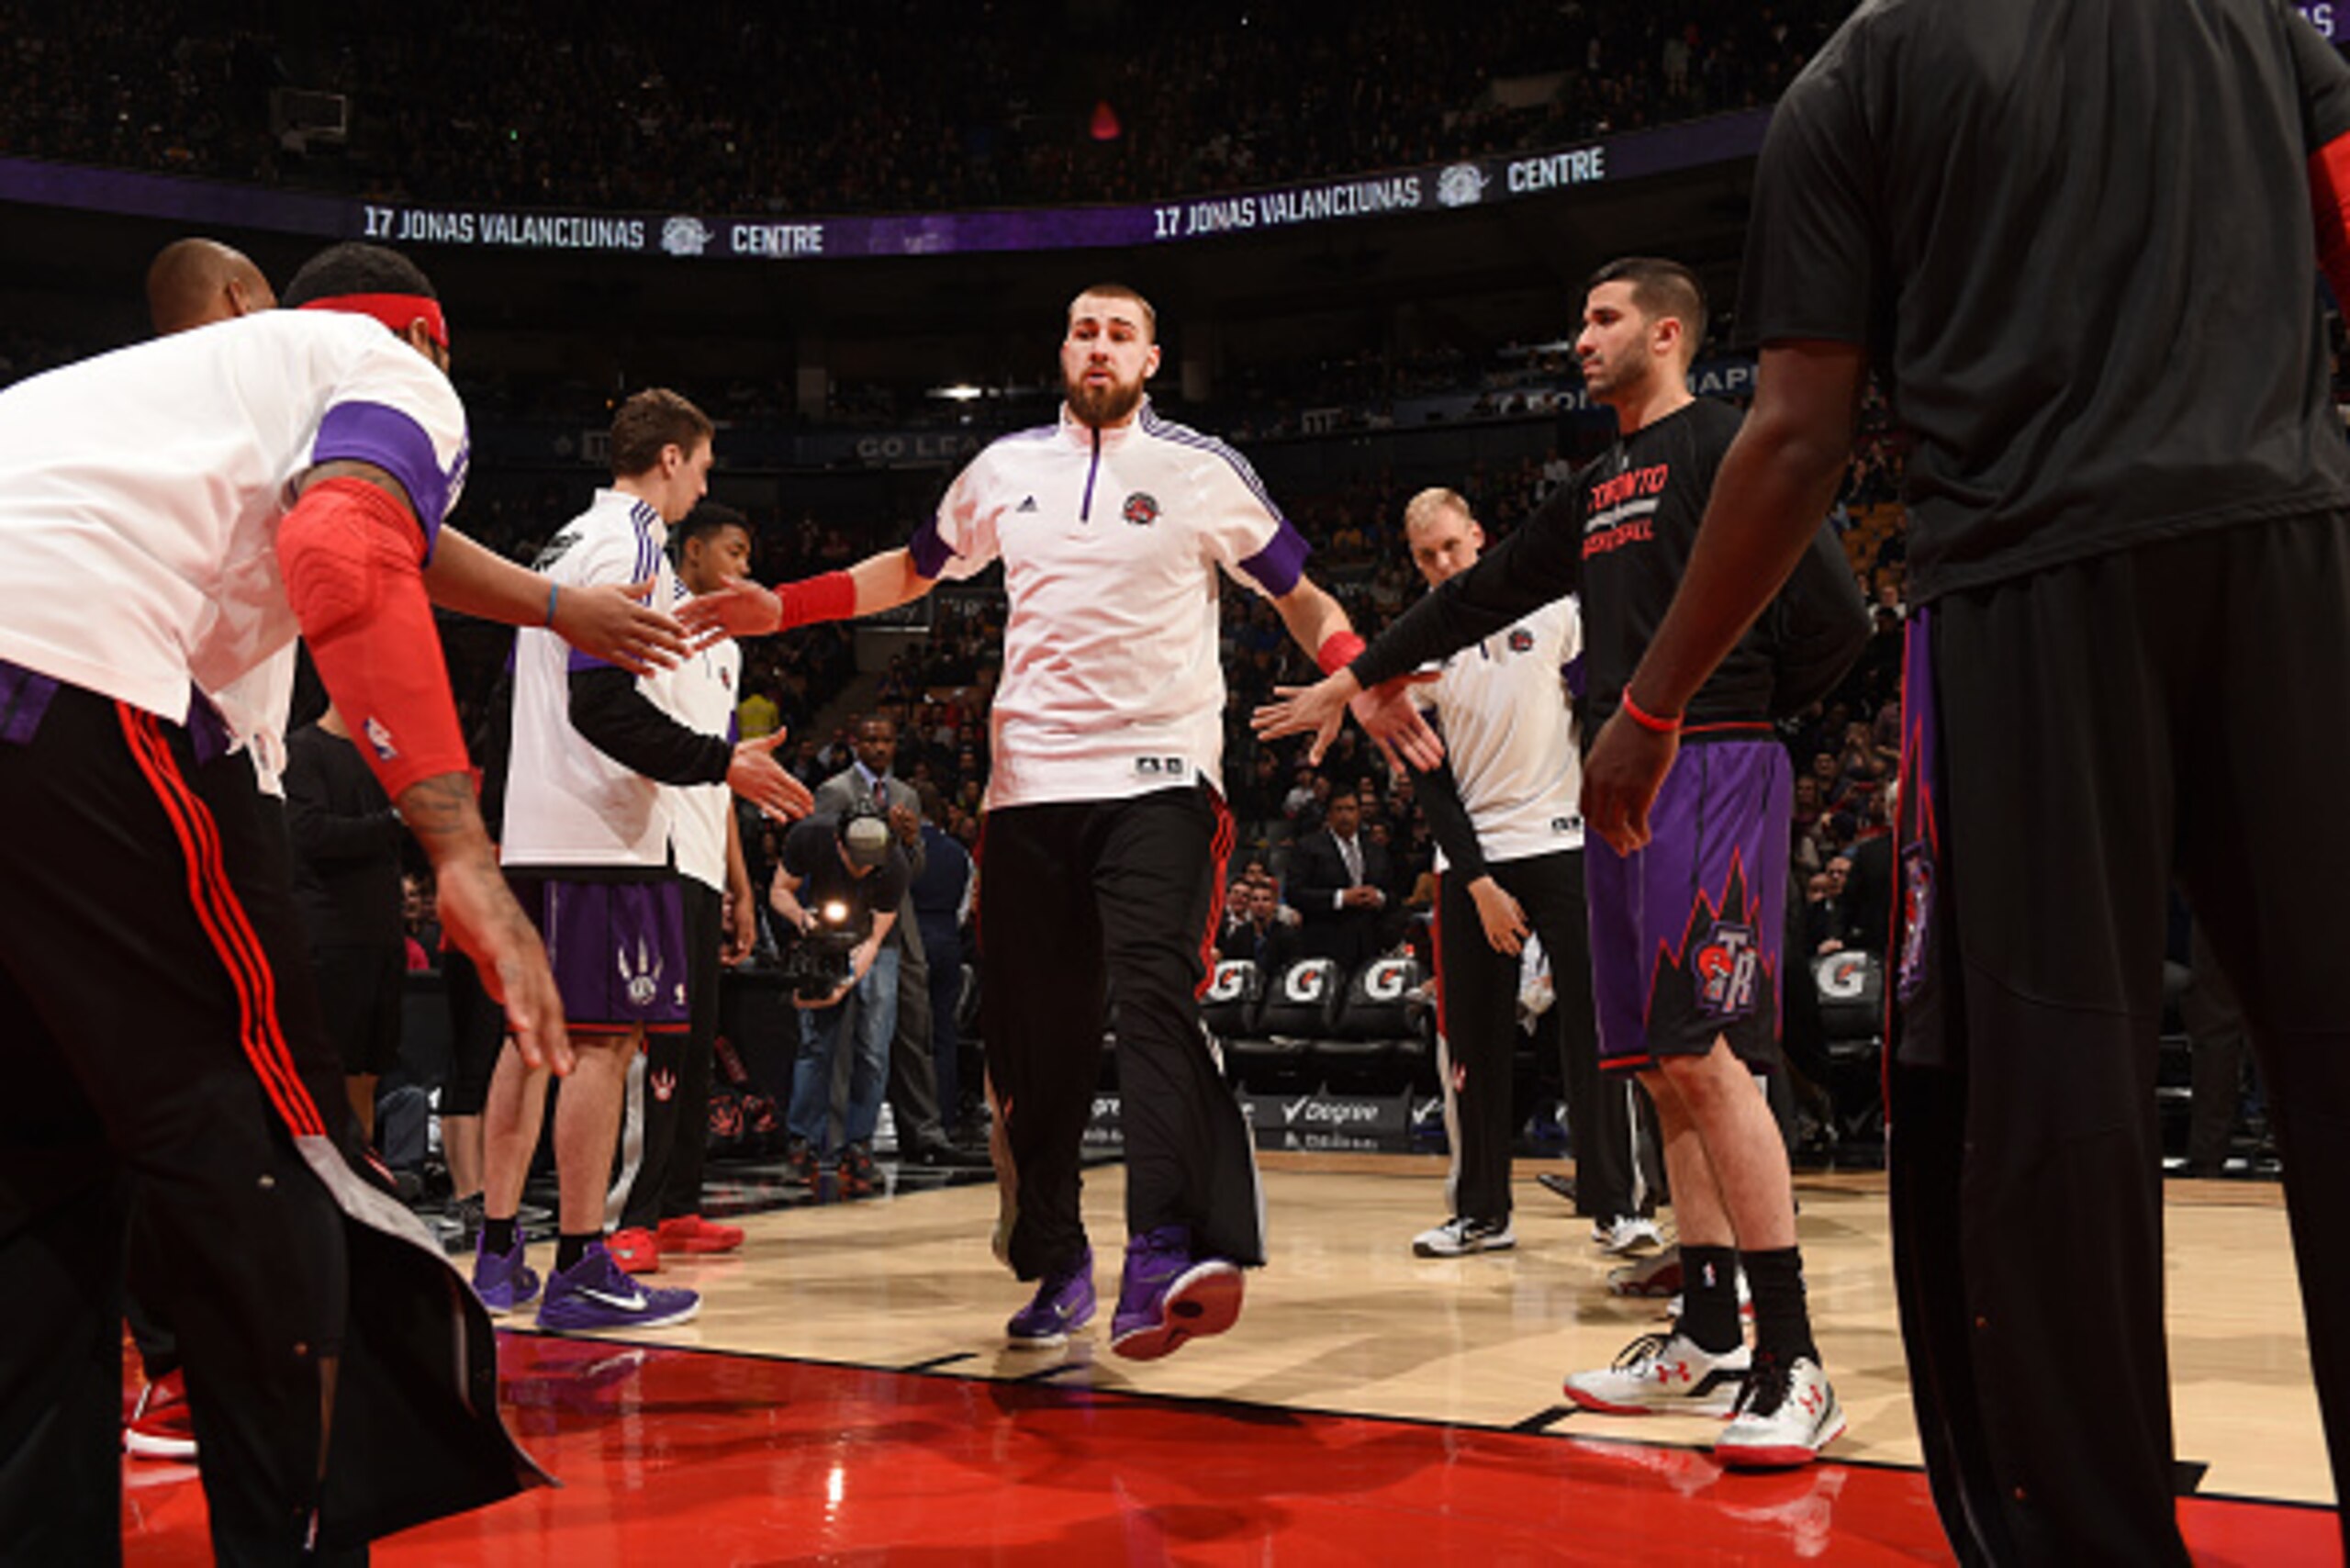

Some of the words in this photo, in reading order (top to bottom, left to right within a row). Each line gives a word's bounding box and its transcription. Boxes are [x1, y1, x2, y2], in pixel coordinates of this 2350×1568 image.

[1154, 207, 1180, 239] 17
[1185, 198, 1256, 235] JONAS
[1260, 177, 1421, 224] VALANCIUNAS
[1507, 146, 1605, 192] CENTRE
[364, 206, 392, 236] 17
[398, 212, 475, 243] JONAS
[479, 215, 644, 248] VALANCIUNAS
[732, 223, 824, 254] CENTRE
[856, 436, 904, 457] GO
[916, 435, 981, 457] LEA
[1286, 959, 1331, 1002] G
[1364, 959, 1410, 1002] G
[1818, 951, 1867, 998] G
[1304, 1101, 1379, 1126] Degree
